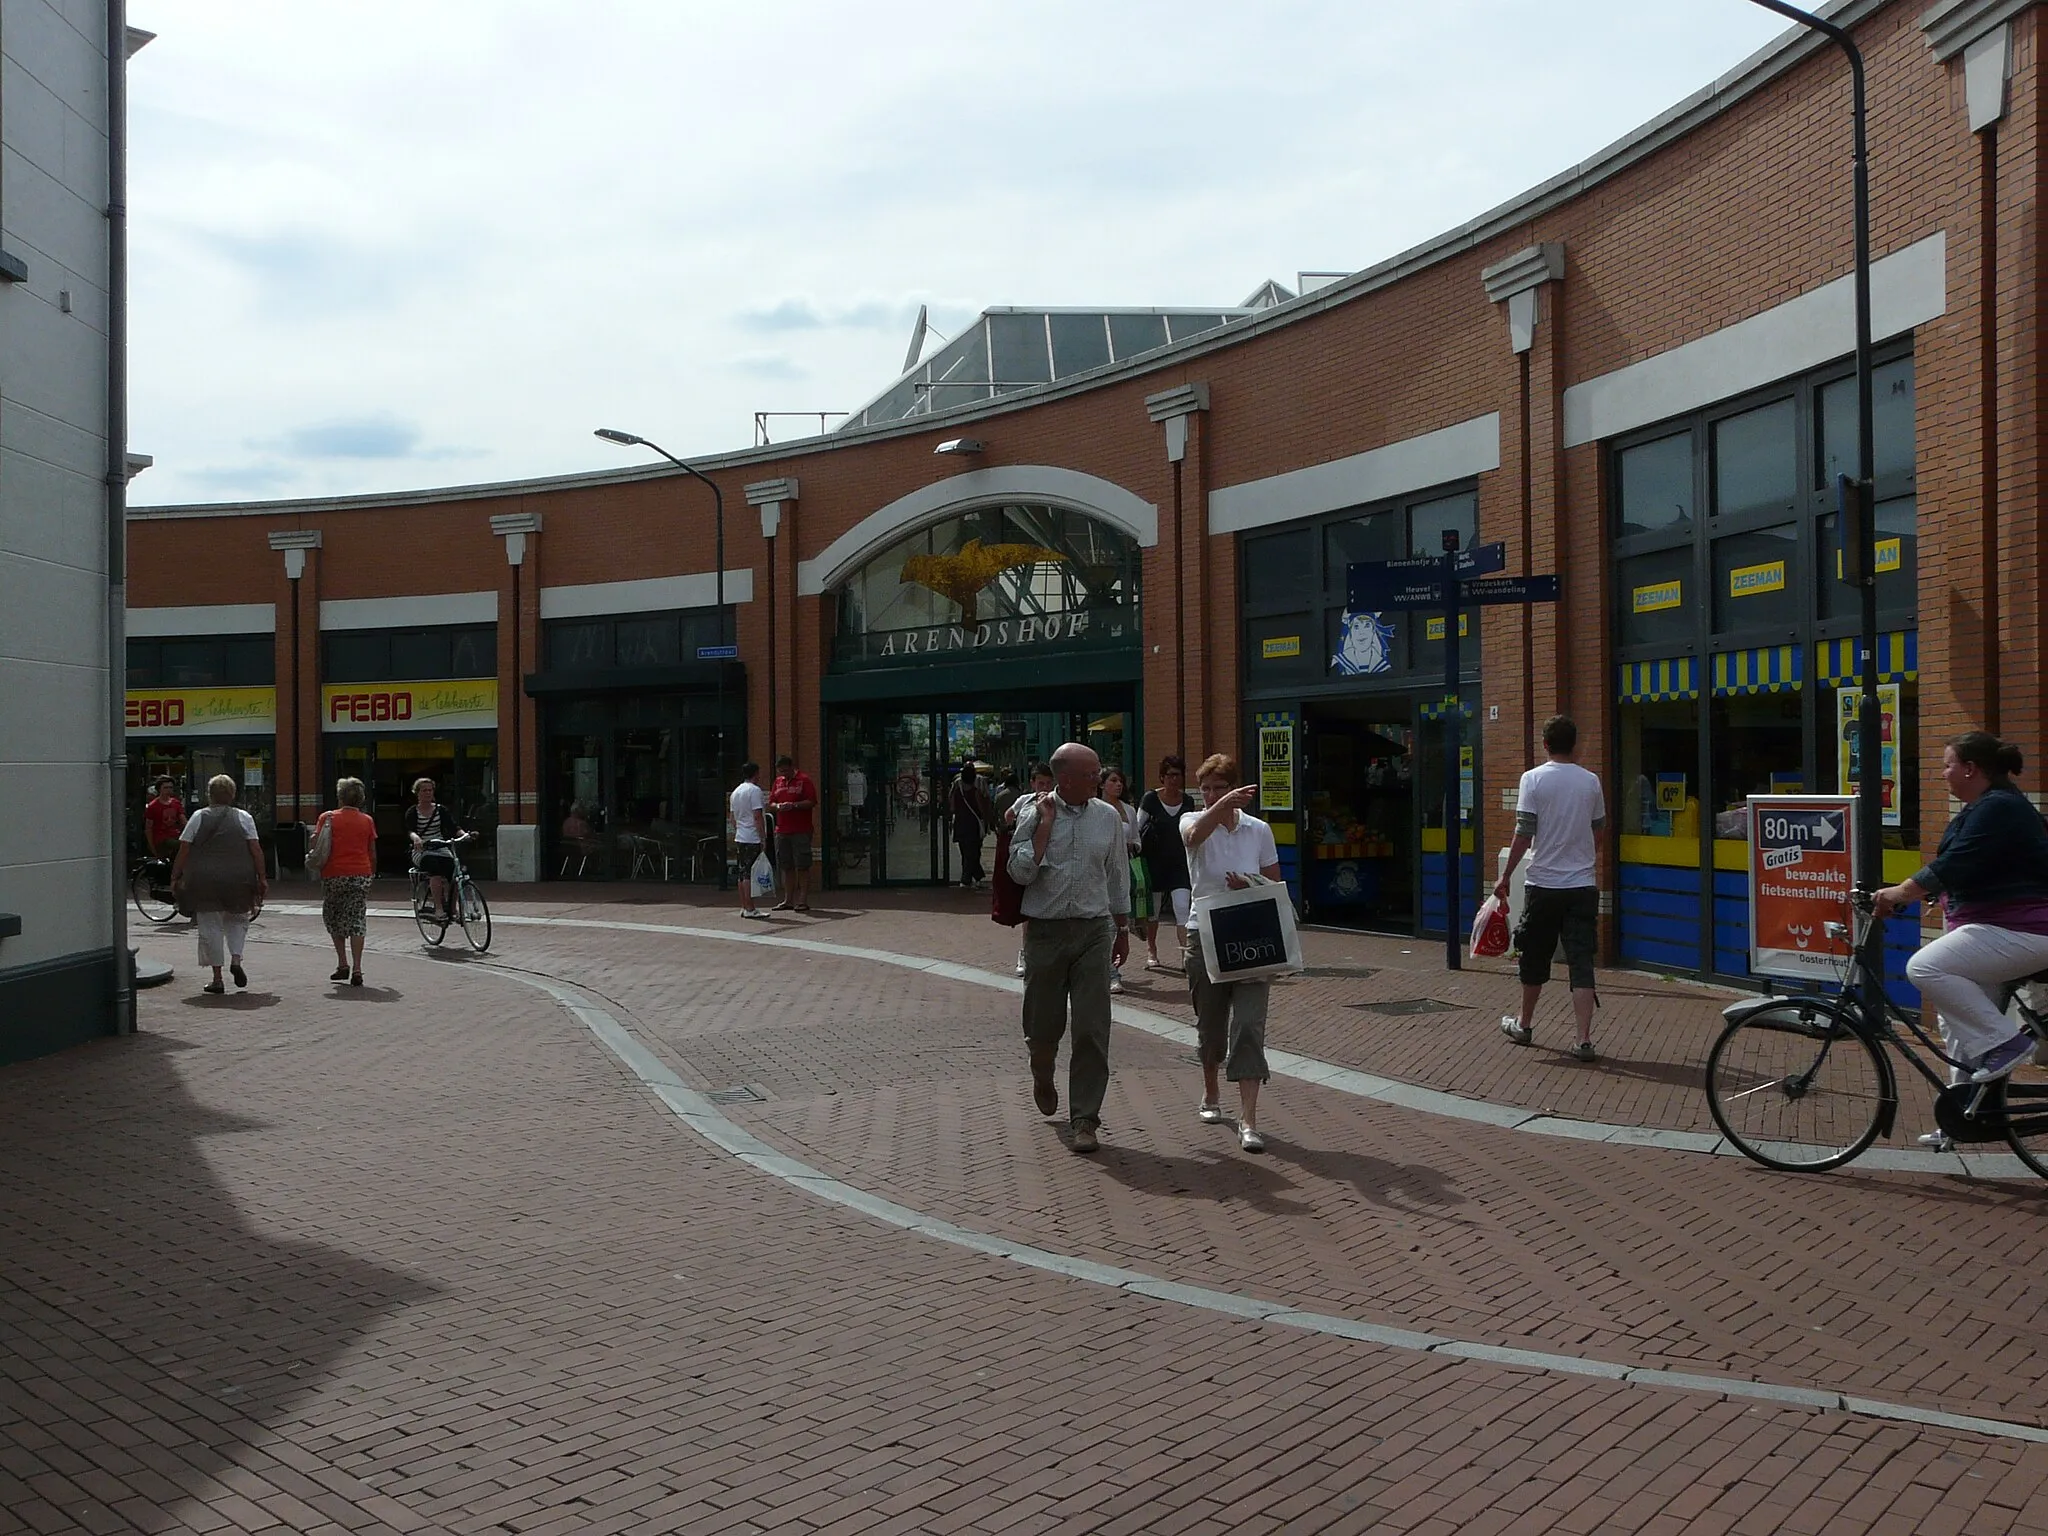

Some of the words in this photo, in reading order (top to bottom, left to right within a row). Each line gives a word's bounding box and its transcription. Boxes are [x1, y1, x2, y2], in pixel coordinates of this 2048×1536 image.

[1733, 567, 1782, 590] ZEEMAN
[1406, 585, 1430, 593] Heuvel
[1637, 588, 1678, 606] ZEEMAN
[880, 613, 1084, 656] ARENDSHOF
[1265, 641, 1297, 653] ZEEMAN
[125, 699, 184, 727] EBO
[330, 692, 412, 723] FEBO
[1262, 731, 1290, 743] WINKEL
[1264, 743, 1288, 760] HULP
[1764, 817, 1809, 840] 80m
[1766, 848, 1799, 867] Gratis
[1785, 867, 1847, 883] bewaakte
[1761, 883, 1848, 904] fietsenstalling
[1225, 940, 1277, 964] Blom
[1799, 953, 1849, 968] Oosterhout
